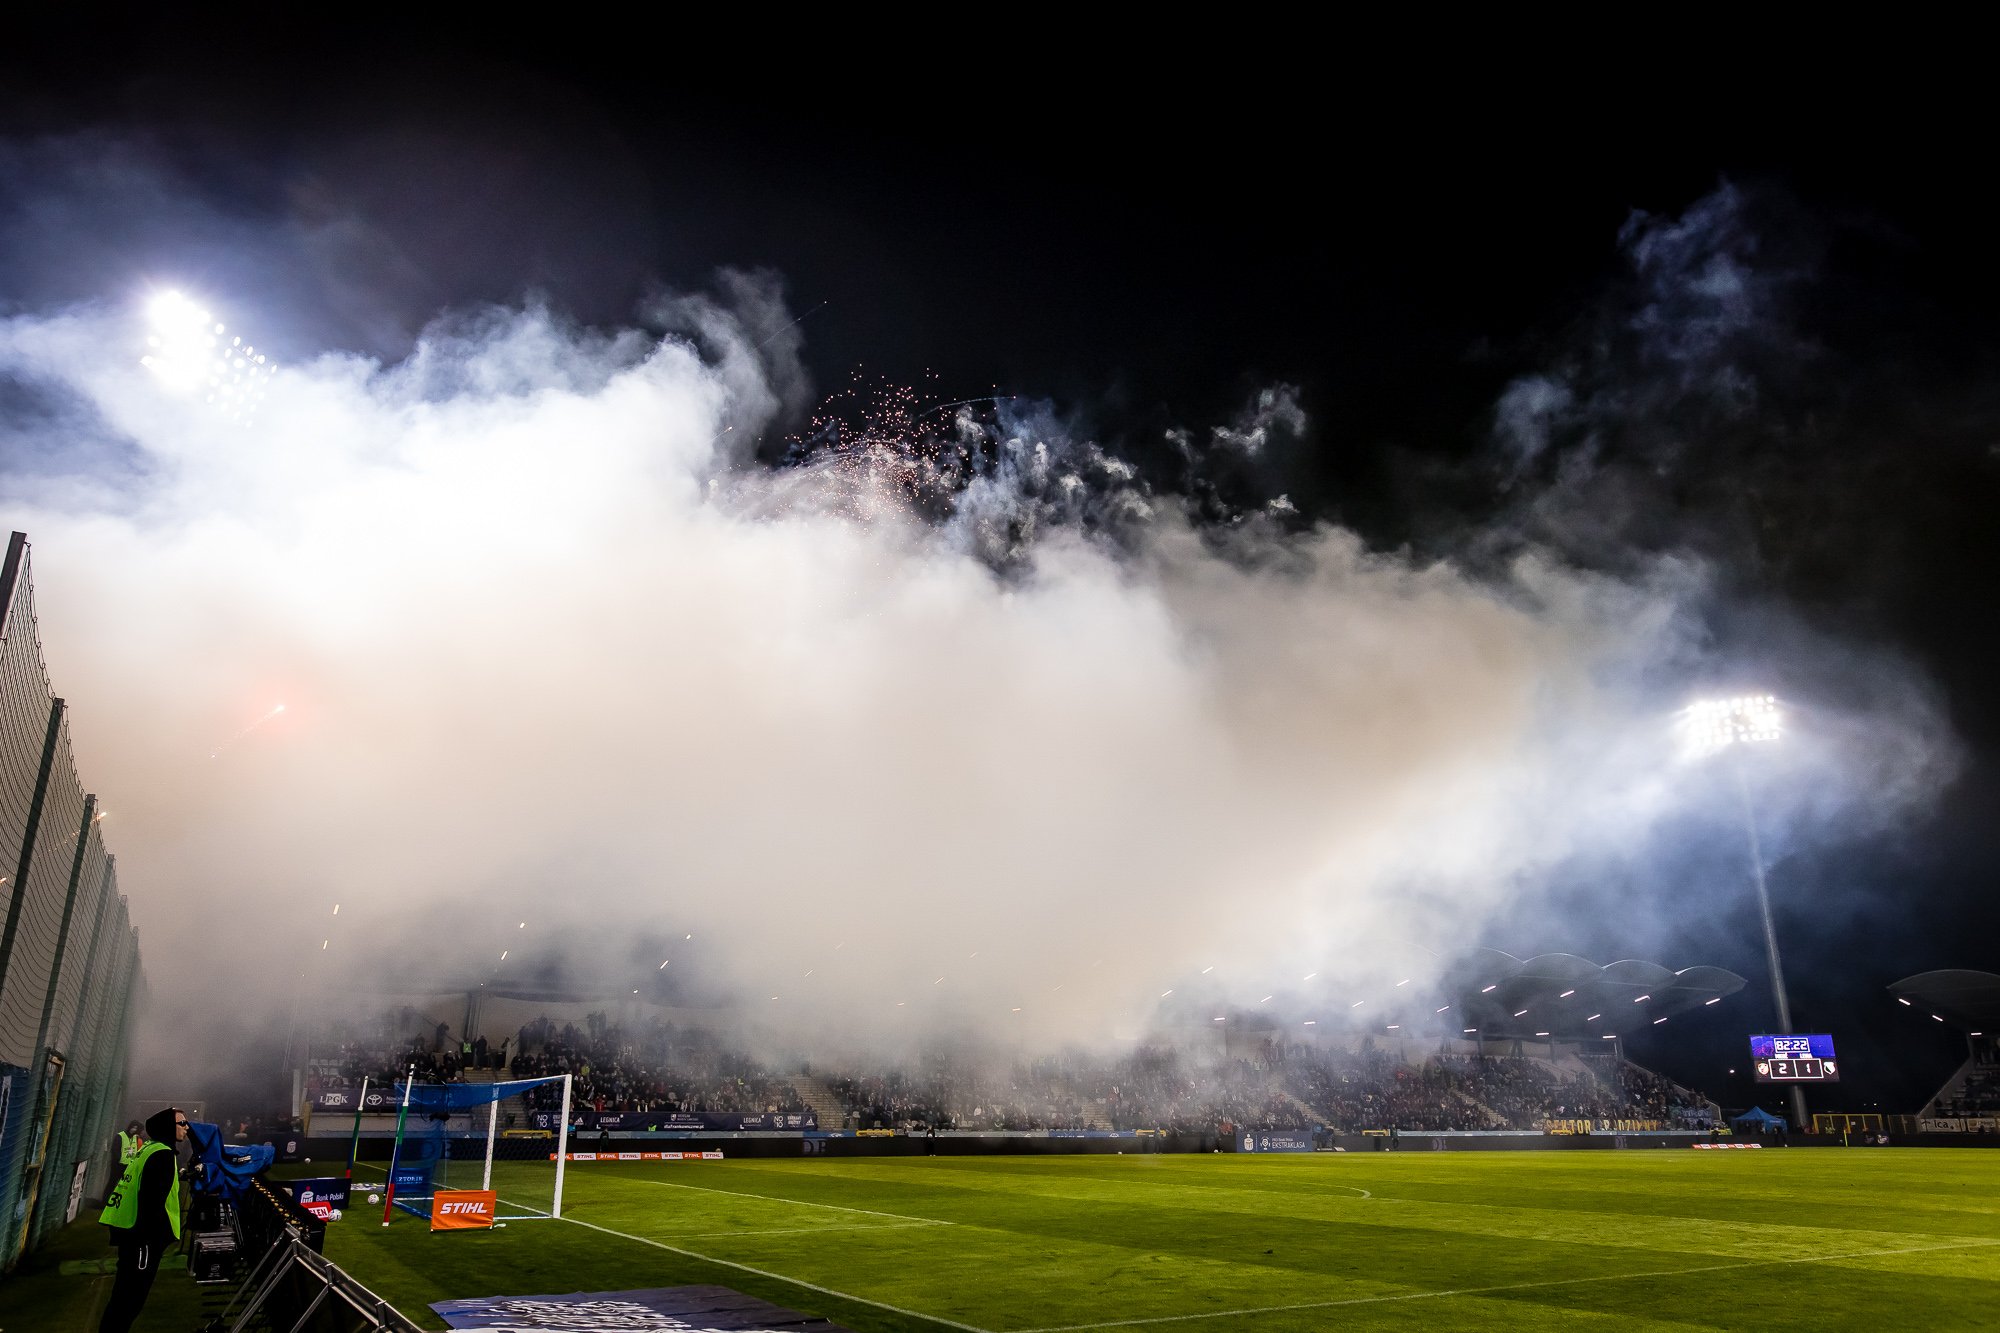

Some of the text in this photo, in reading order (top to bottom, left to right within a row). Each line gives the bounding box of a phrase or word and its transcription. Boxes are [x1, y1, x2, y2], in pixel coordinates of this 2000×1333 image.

[1776, 1040, 1807, 1050] 82:22
[1779, 1063, 1787, 1074] 2
[1806, 1063, 1811, 1073] 1
[320, 1094, 349, 1105] LPGK
[1271, 1141, 1305, 1149] EKSTRAKLASA
[316, 1192, 344, 1202] Bank Polski
[440, 1202, 488, 1215] STIHL
